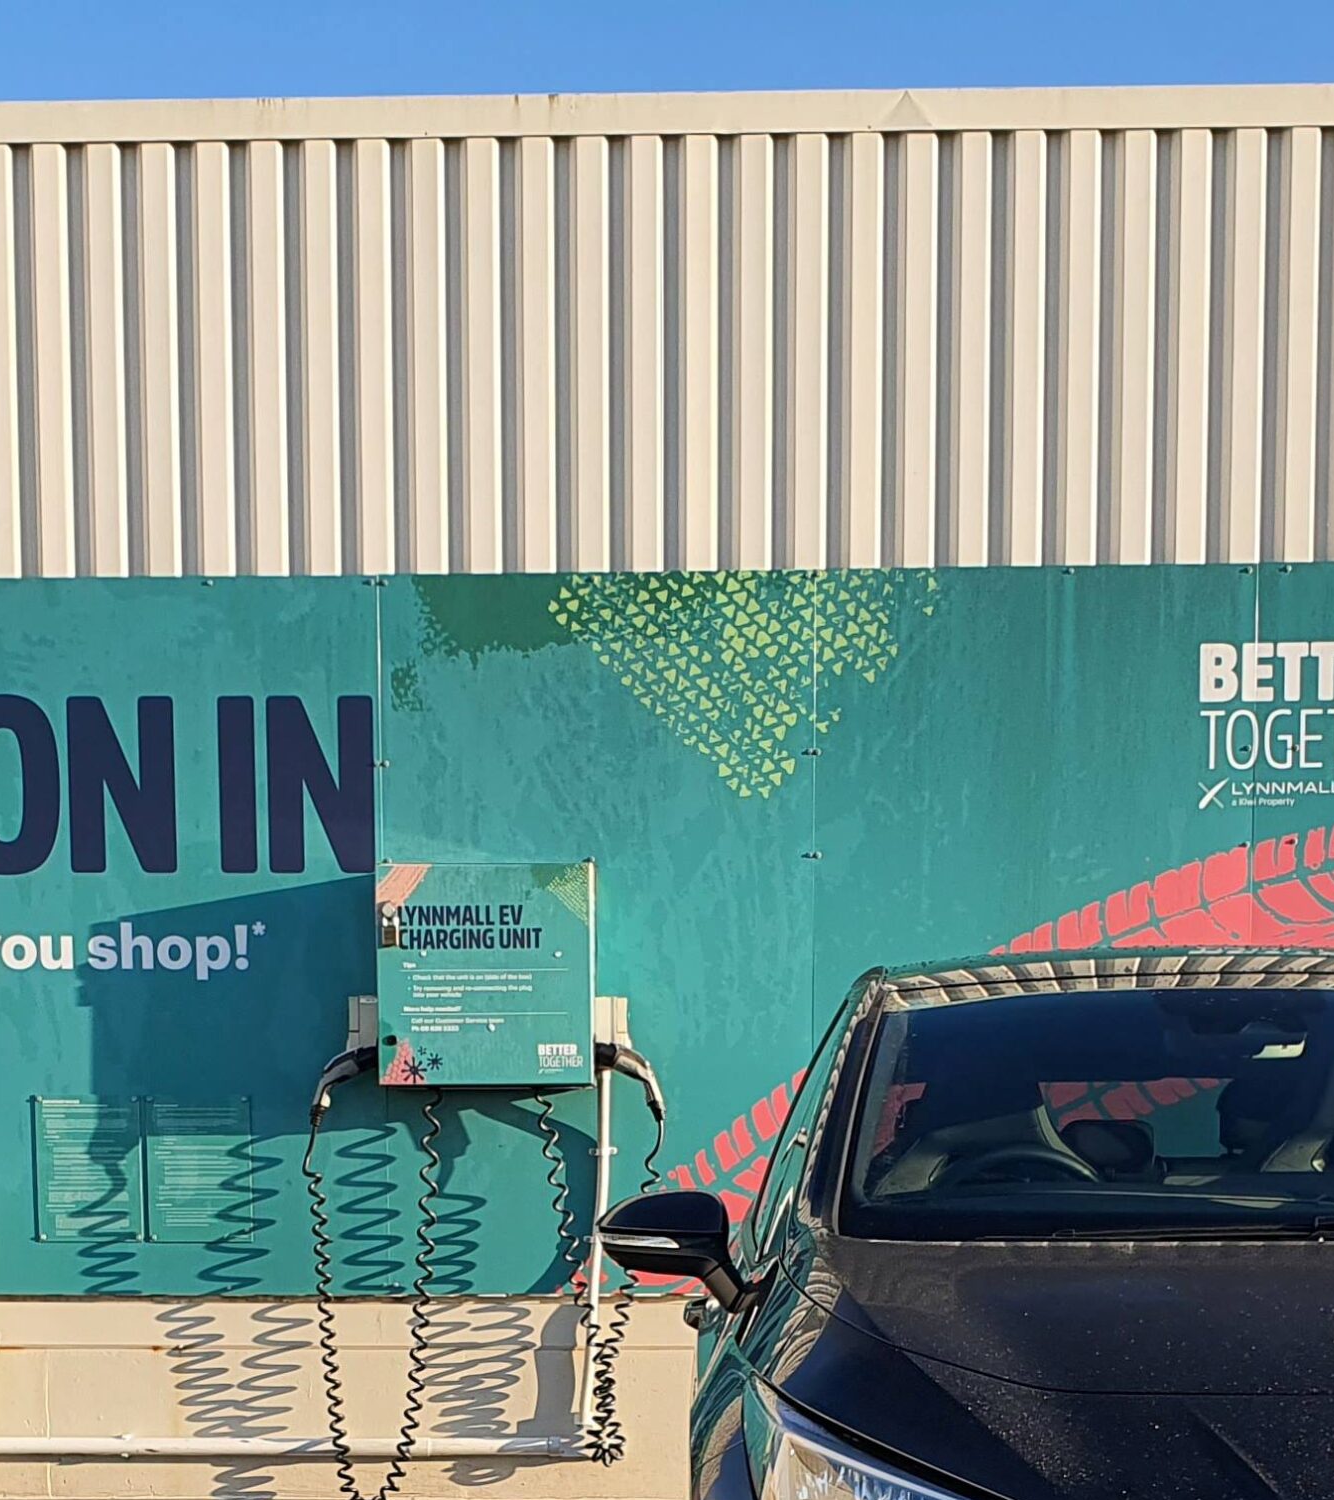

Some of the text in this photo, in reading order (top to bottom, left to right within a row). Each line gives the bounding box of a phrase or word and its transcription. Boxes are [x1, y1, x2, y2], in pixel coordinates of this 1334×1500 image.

[217, 694, 376, 876] IN
[1258, 797, 1295, 809] Property
[397, 904, 523, 926] LYNNMALL EV
[399, 928, 543, 949] CHARGING UNIT
[538, 1044, 577, 1056] BETTER
[539, 1055, 584, 1068] TOGETHER
